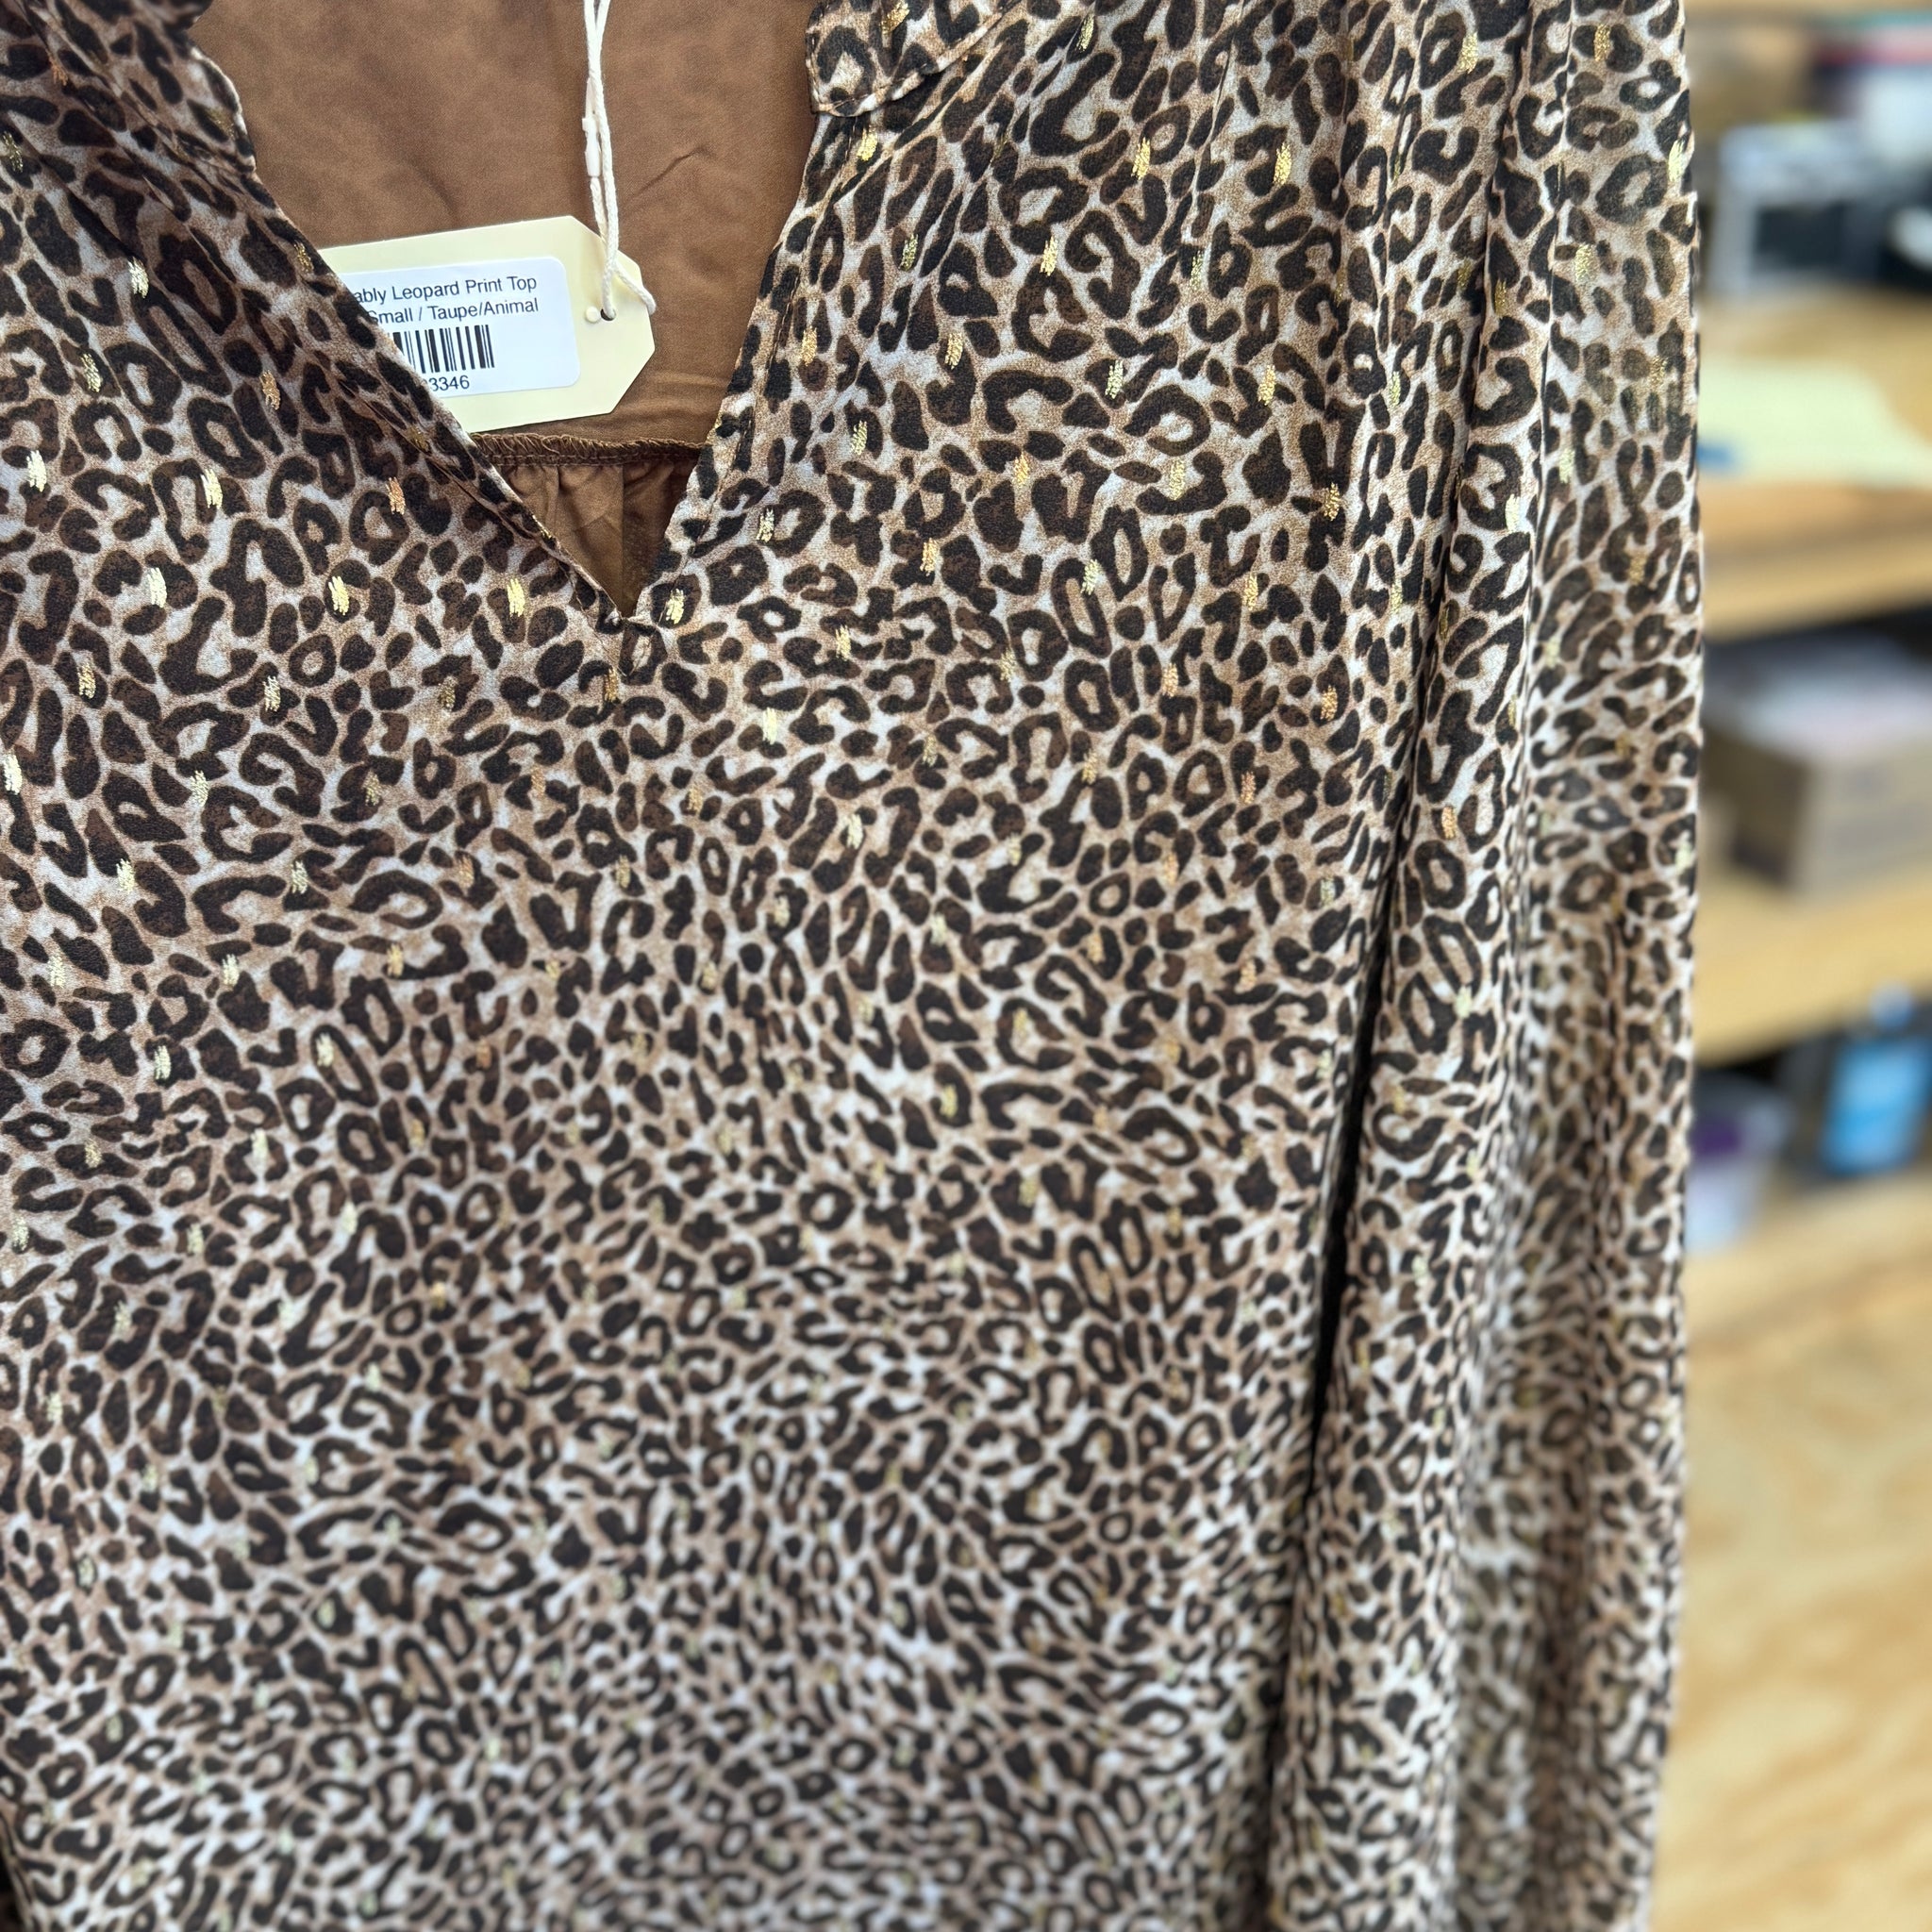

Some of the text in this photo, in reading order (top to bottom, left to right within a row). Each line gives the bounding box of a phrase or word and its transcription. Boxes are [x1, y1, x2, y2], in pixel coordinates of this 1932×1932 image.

[354, 275, 537, 306] ably Leopard Print Top
[367, 297, 539, 324] Small / Taupe/Animal
[422, 375, 470, 392] 3346
